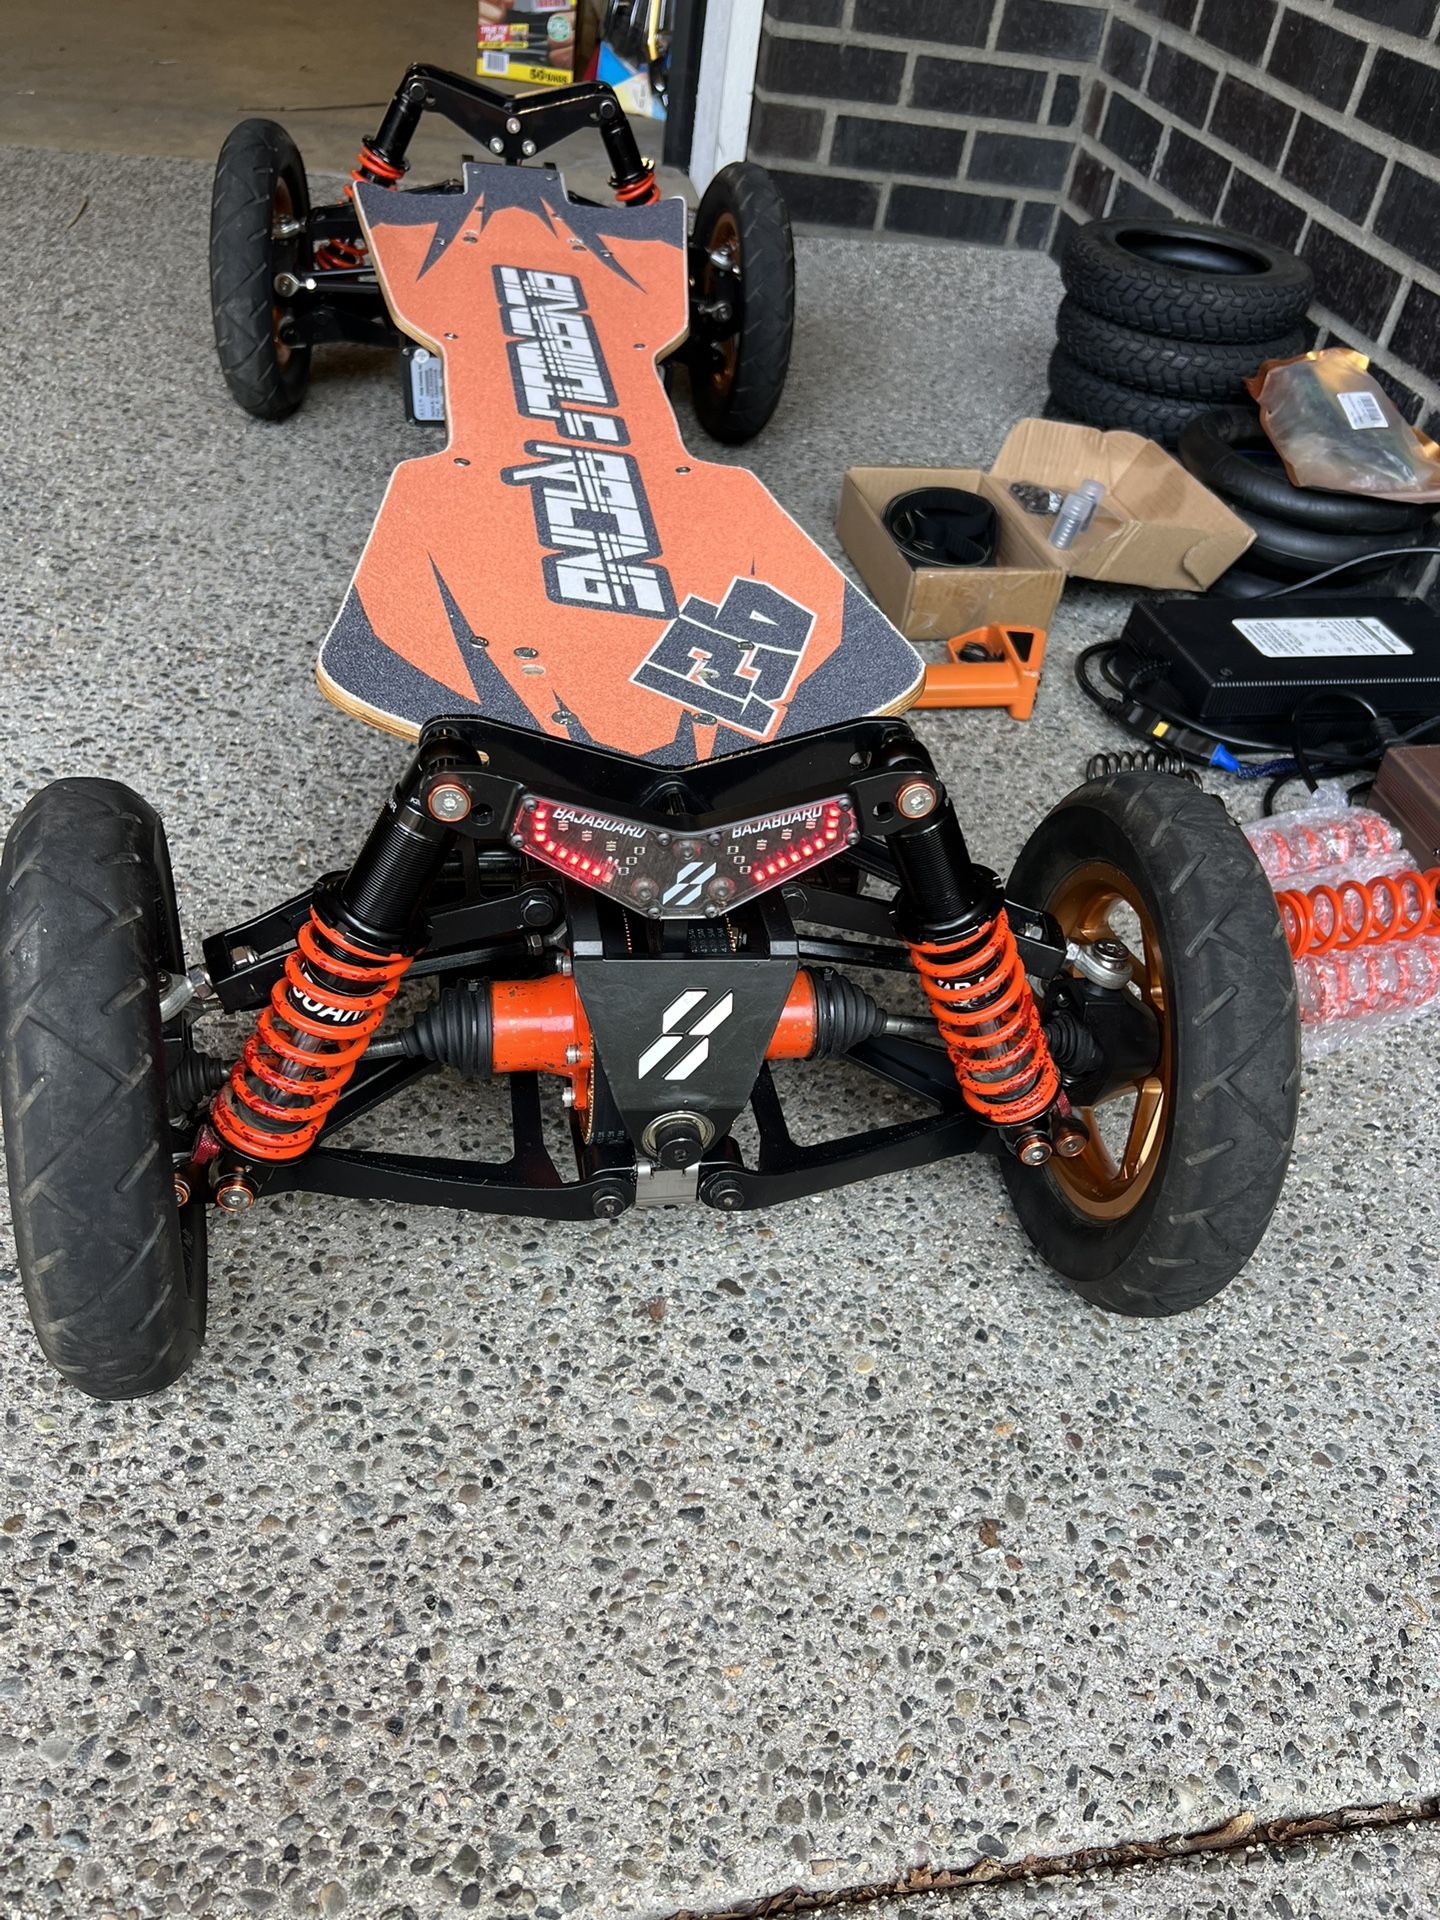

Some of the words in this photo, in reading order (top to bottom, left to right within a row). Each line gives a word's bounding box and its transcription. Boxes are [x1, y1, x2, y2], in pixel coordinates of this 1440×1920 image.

[507, 441, 673, 616] RACING
[552, 807, 647, 839] BAJABOARD
[732, 805, 823, 839] BAJABOARD
